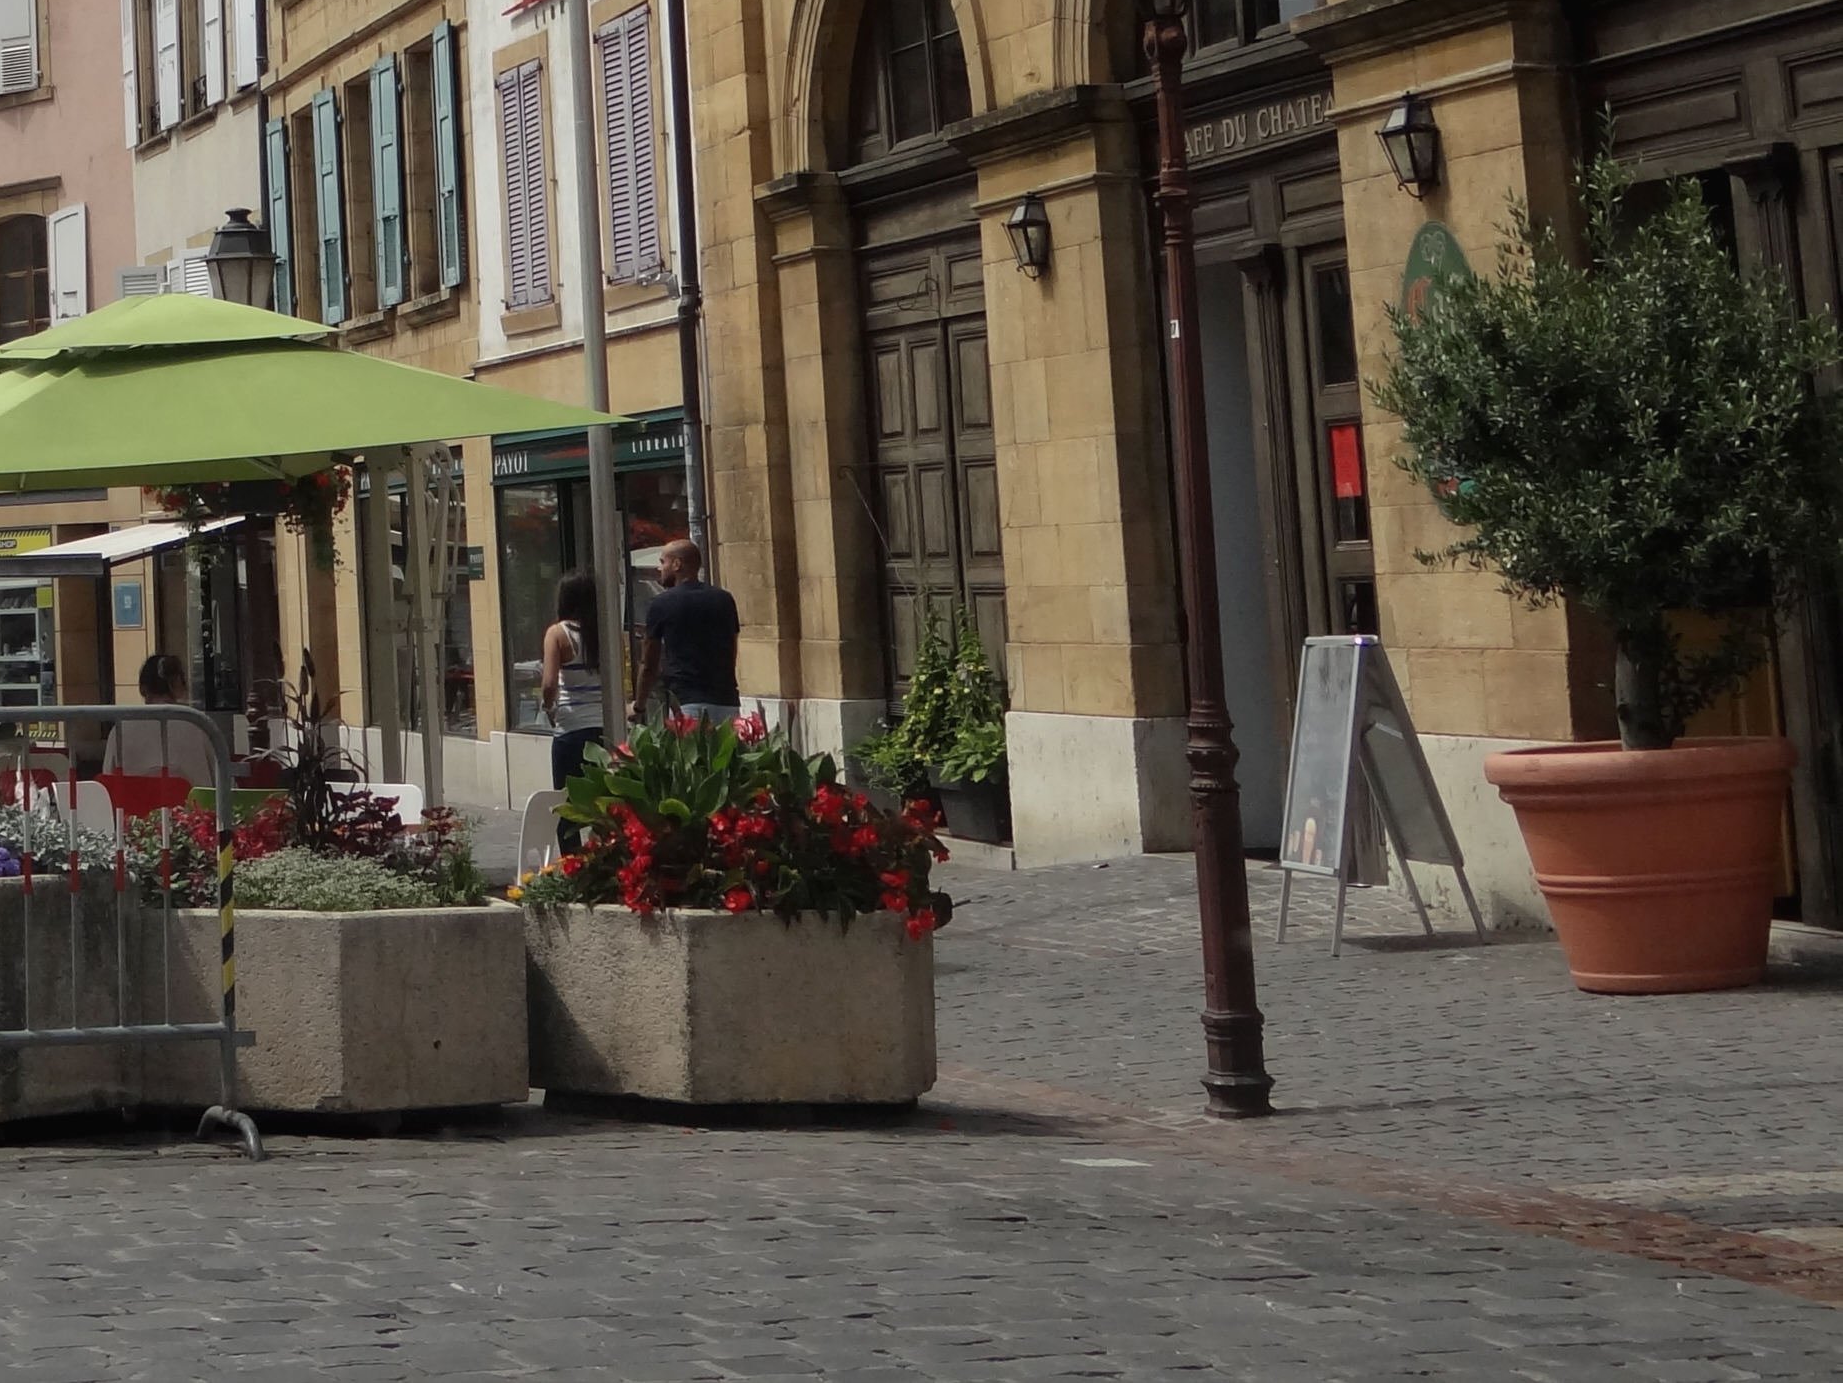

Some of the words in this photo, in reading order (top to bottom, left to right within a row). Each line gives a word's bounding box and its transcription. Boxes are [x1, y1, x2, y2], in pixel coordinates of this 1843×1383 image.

[1184, 124, 1214, 157] AFE
[1222, 114, 1247, 148] DU
[1258, 92, 1335, 138] CHATEA
[494, 451, 529, 475] PAYOT
